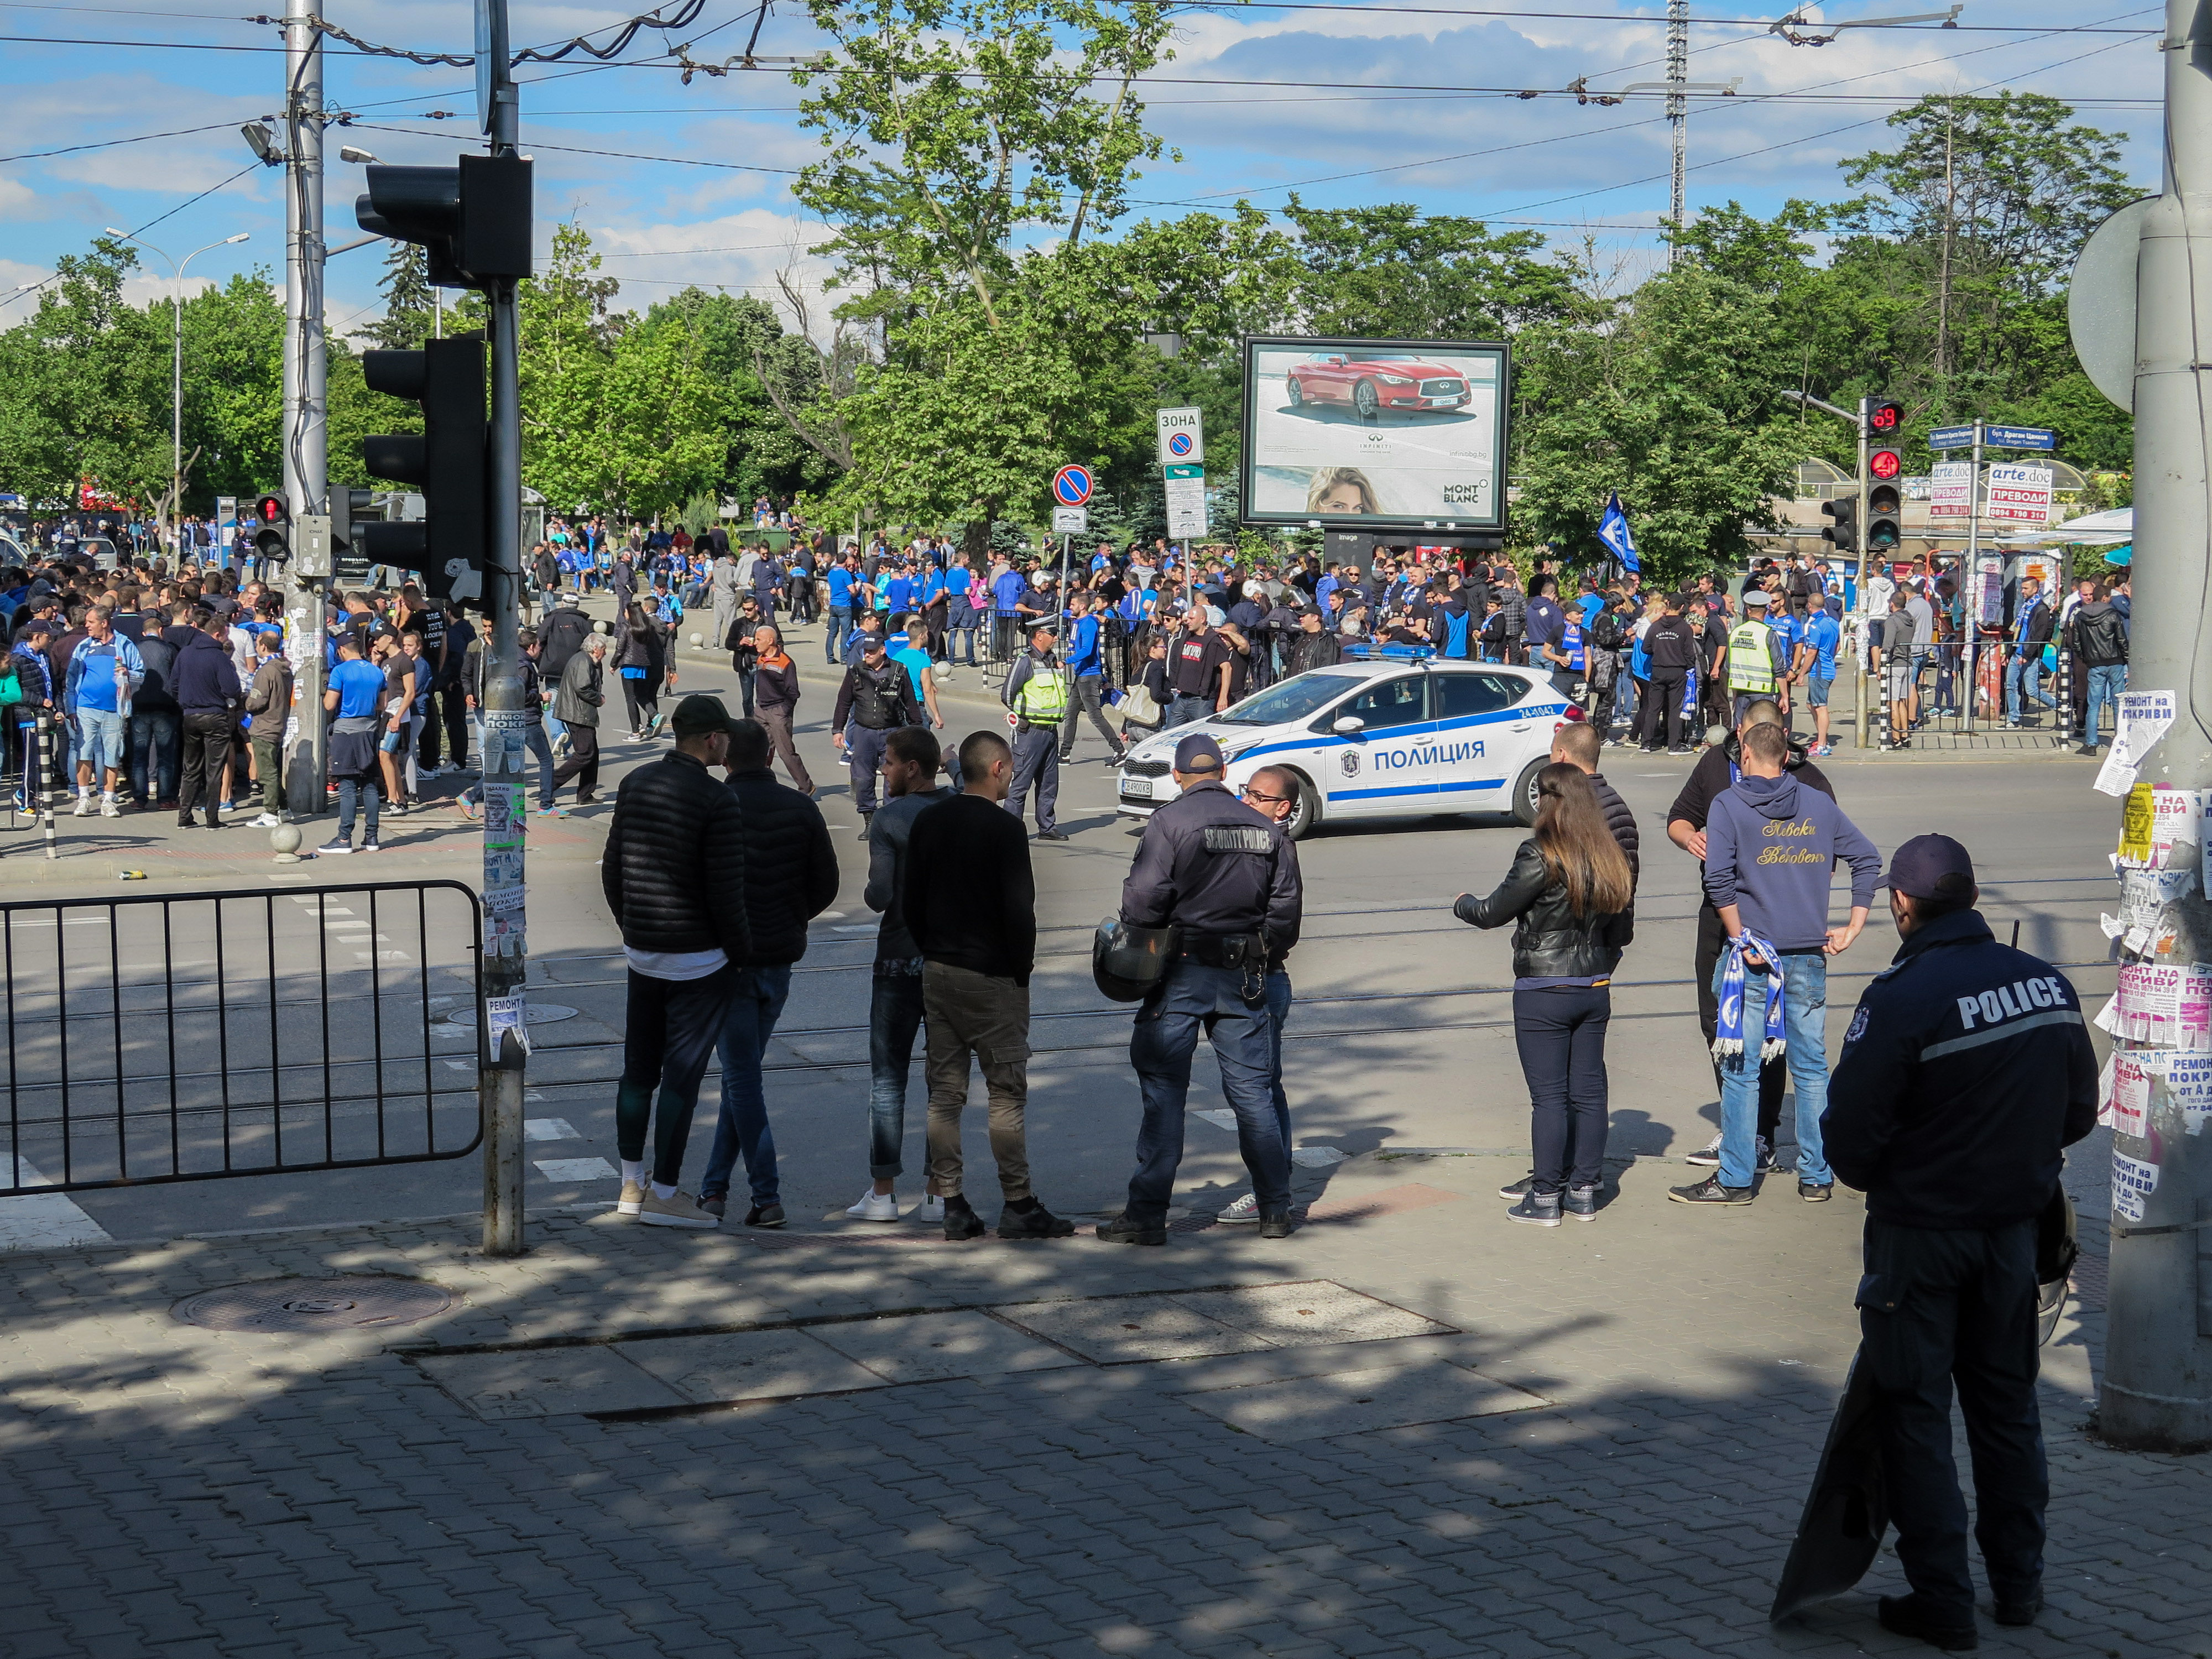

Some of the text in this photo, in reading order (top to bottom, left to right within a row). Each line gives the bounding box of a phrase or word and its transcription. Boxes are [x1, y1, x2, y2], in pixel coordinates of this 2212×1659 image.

[1161, 415, 1196, 427] ЗОНА
[1992, 429, 2048, 441] бул. Драган Цанков
[1449, 451, 1487, 459] infinitibg.bg
[1933, 464, 1970, 477] arte.doc
[1992, 468, 2050, 483] arte.doc
[1444, 485, 1479, 494] MONT
[1933, 488, 1968, 498] ПРЕВОДИ
[1444, 494, 1479, 503] BLANC
[1992, 489, 2047, 503] ПРЕВОДИ
[1339, 534, 1358, 542] Image
[2124, 696, 2153, 707] РЕМОНТ
[1519, 706, 1556, 719] 24-1042
[2122, 708, 2172, 719] ПОКРИВИ
[1374, 740, 1485, 771] ПОЛИЦИЯ
[2163, 796, 2185, 805] НА
[1762, 817, 1816, 837] Левски
[1243, 829, 1271, 850] POLICE
[2157, 969, 2179, 978] НА
[489, 998, 520, 1011] РЕМОНТ
[1957, 977, 2068, 1030] POLICE
[2126, 1061, 2140, 1072] НА
[2196, 1084, 2203, 1095] А
[2138, 1168, 2151, 1179] на
